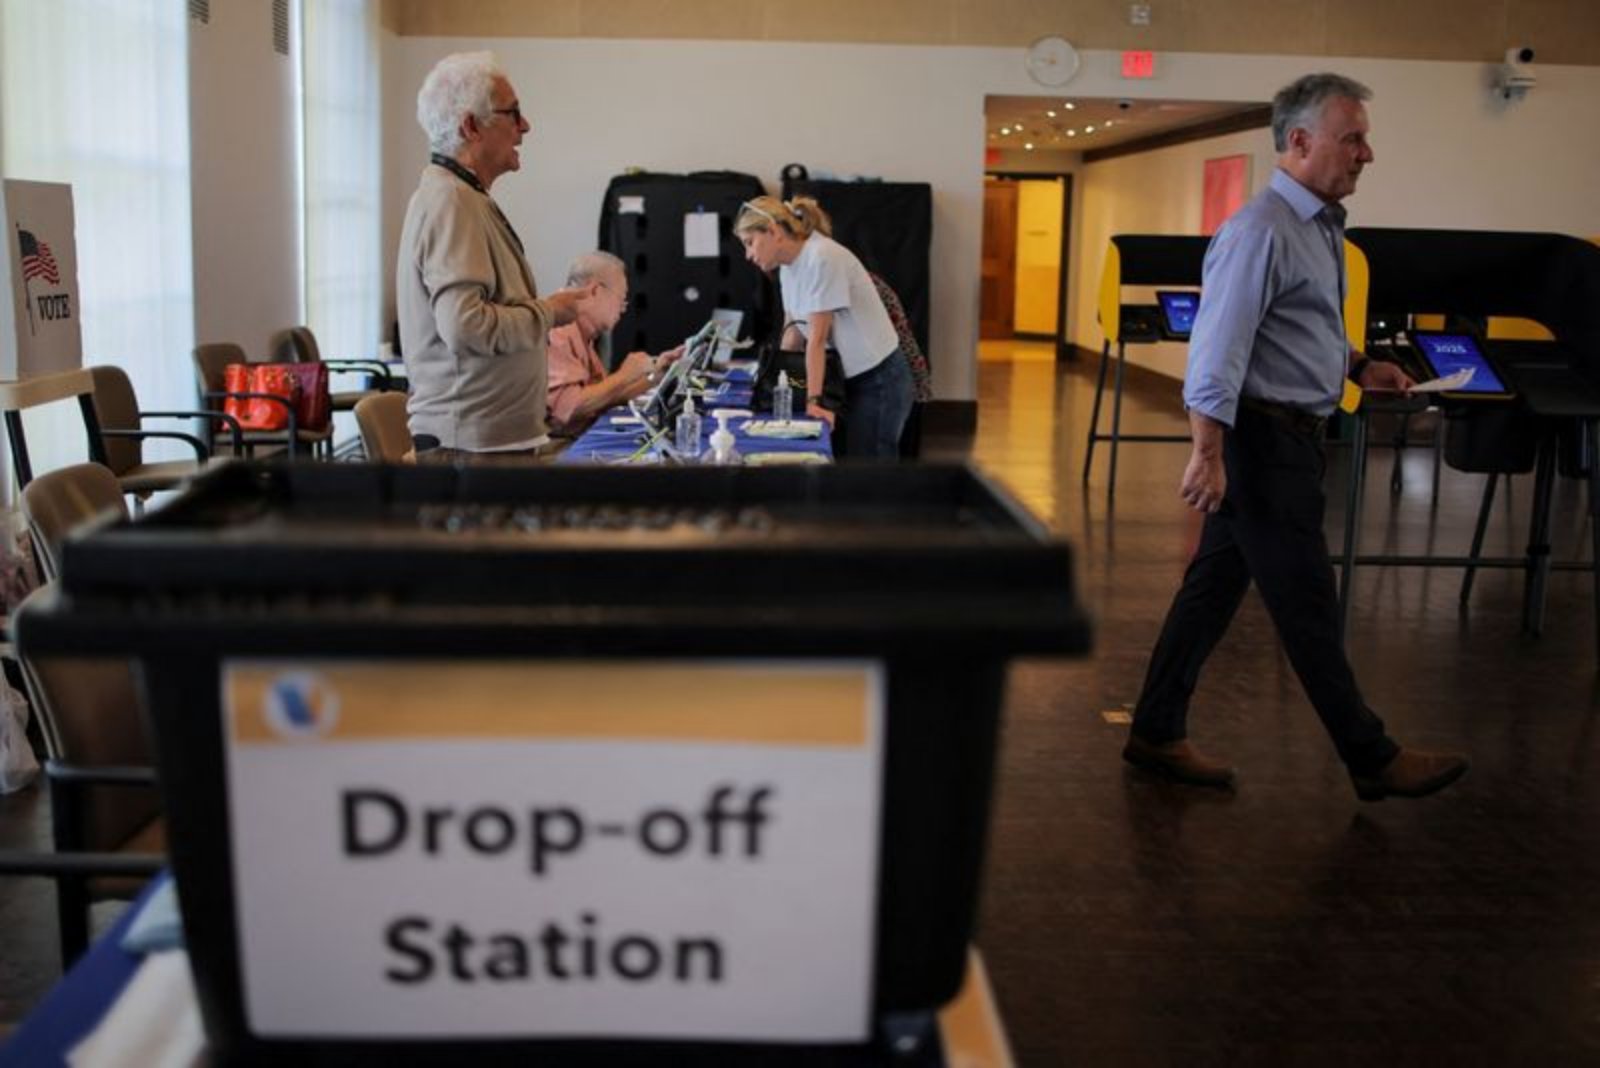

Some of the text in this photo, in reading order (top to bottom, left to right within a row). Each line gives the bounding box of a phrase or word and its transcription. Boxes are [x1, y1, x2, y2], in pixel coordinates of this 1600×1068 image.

[37, 293, 71, 320] VOTE
[340, 786, 774, 876] Drop-off
[383, 913, 724, 985] Station
